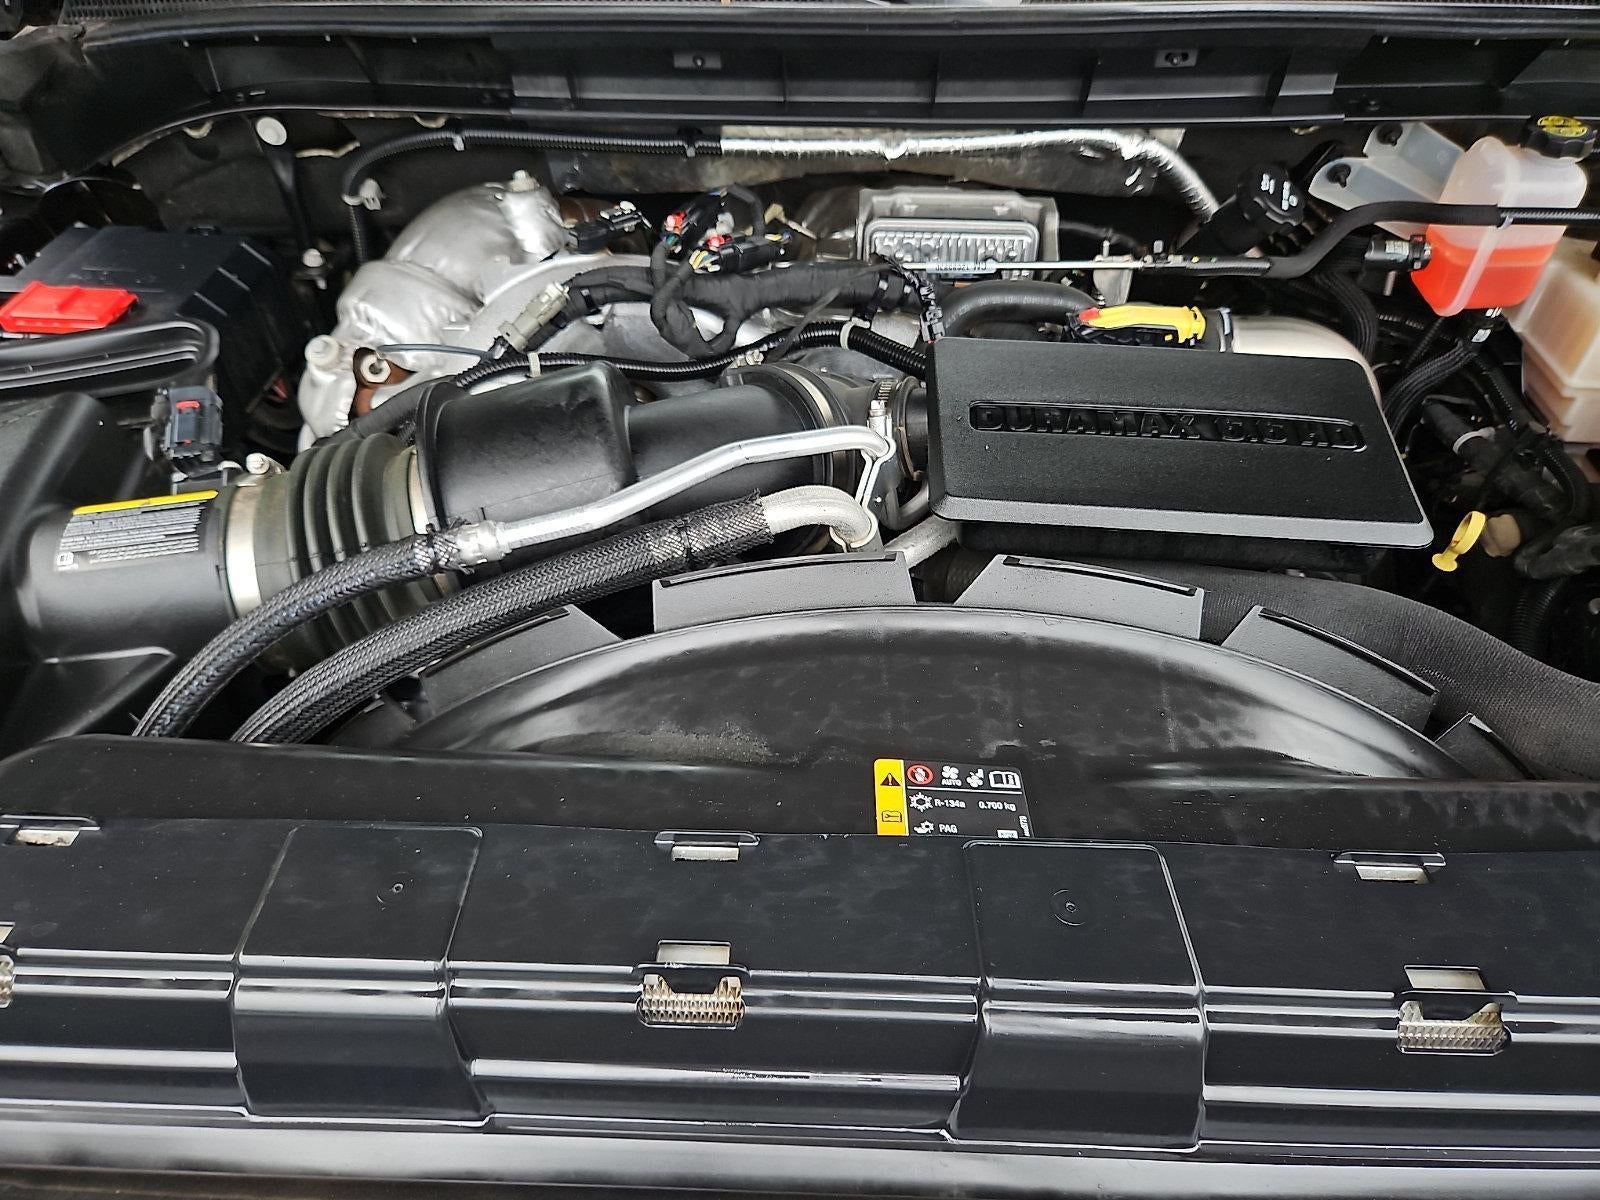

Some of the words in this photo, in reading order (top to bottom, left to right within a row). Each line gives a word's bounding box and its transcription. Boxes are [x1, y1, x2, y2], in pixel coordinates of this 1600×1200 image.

[975, 404, 1201, 440] DURAMAX
[941, 778, 962, 787] AUTO
[934, 799, 966, 809] R-134a
[978, 800, 1003, 810] 0.700
[1004, 801, 1017, 812] kg
[938, 823, 958, 834] PAG
